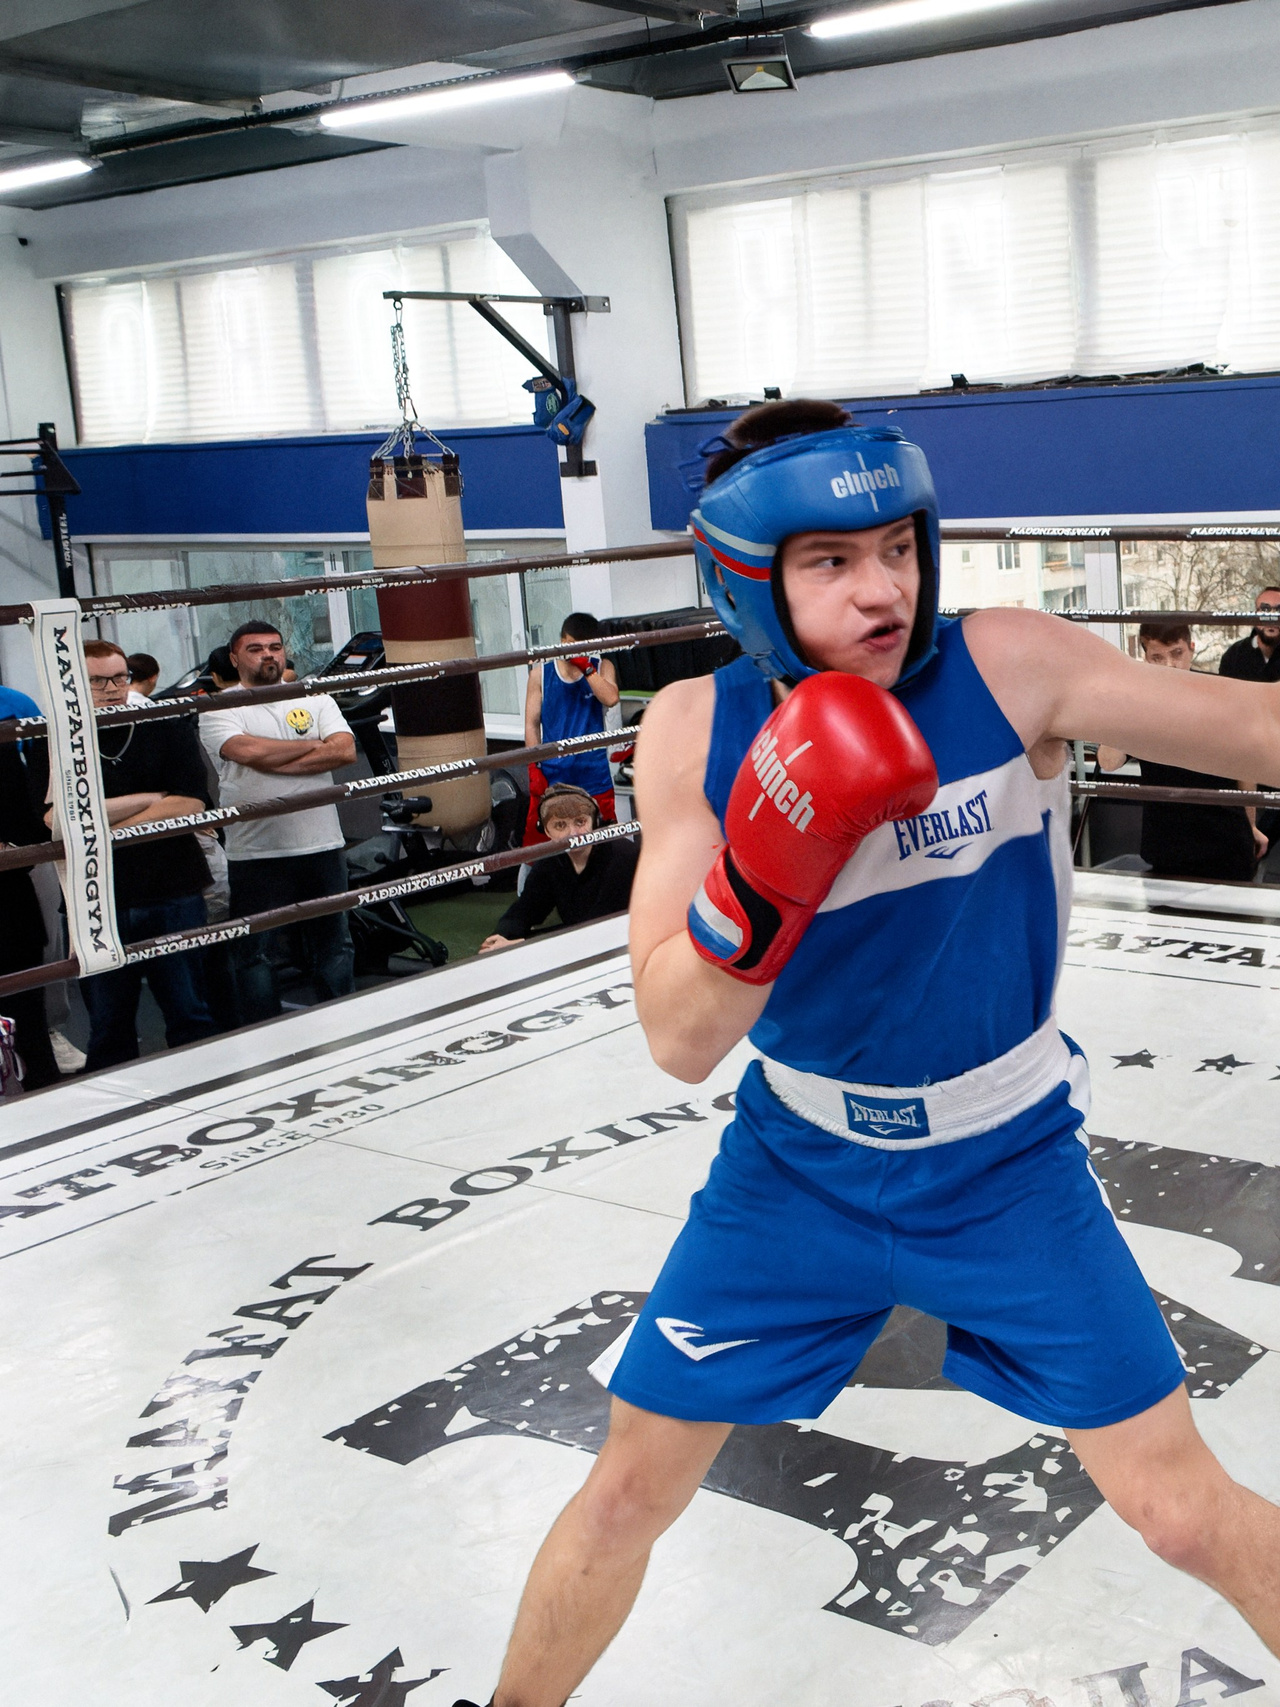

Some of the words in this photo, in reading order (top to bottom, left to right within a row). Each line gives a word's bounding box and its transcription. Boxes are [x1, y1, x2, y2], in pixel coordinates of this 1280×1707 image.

[830, 462, 901, 499] clinch
[53, 625, 109, 954] MAYFATBOXINGGYM
[751, 728, 815, 834] clinch
[110, 806, 241, 840] MAYFATBOXING
[568, 820, 643, 848] TBOXINGGYM
[893, 789, 992, 861] EVERLAST
[358, 862, 485, 905] MAYFATBOXINGGYM
[126, 924, 251, 964] MAYFATBOXING
[0, 983, 635, 1228] TBOXINGGY
[849, 1098, 918, 1128] EVERLAST
